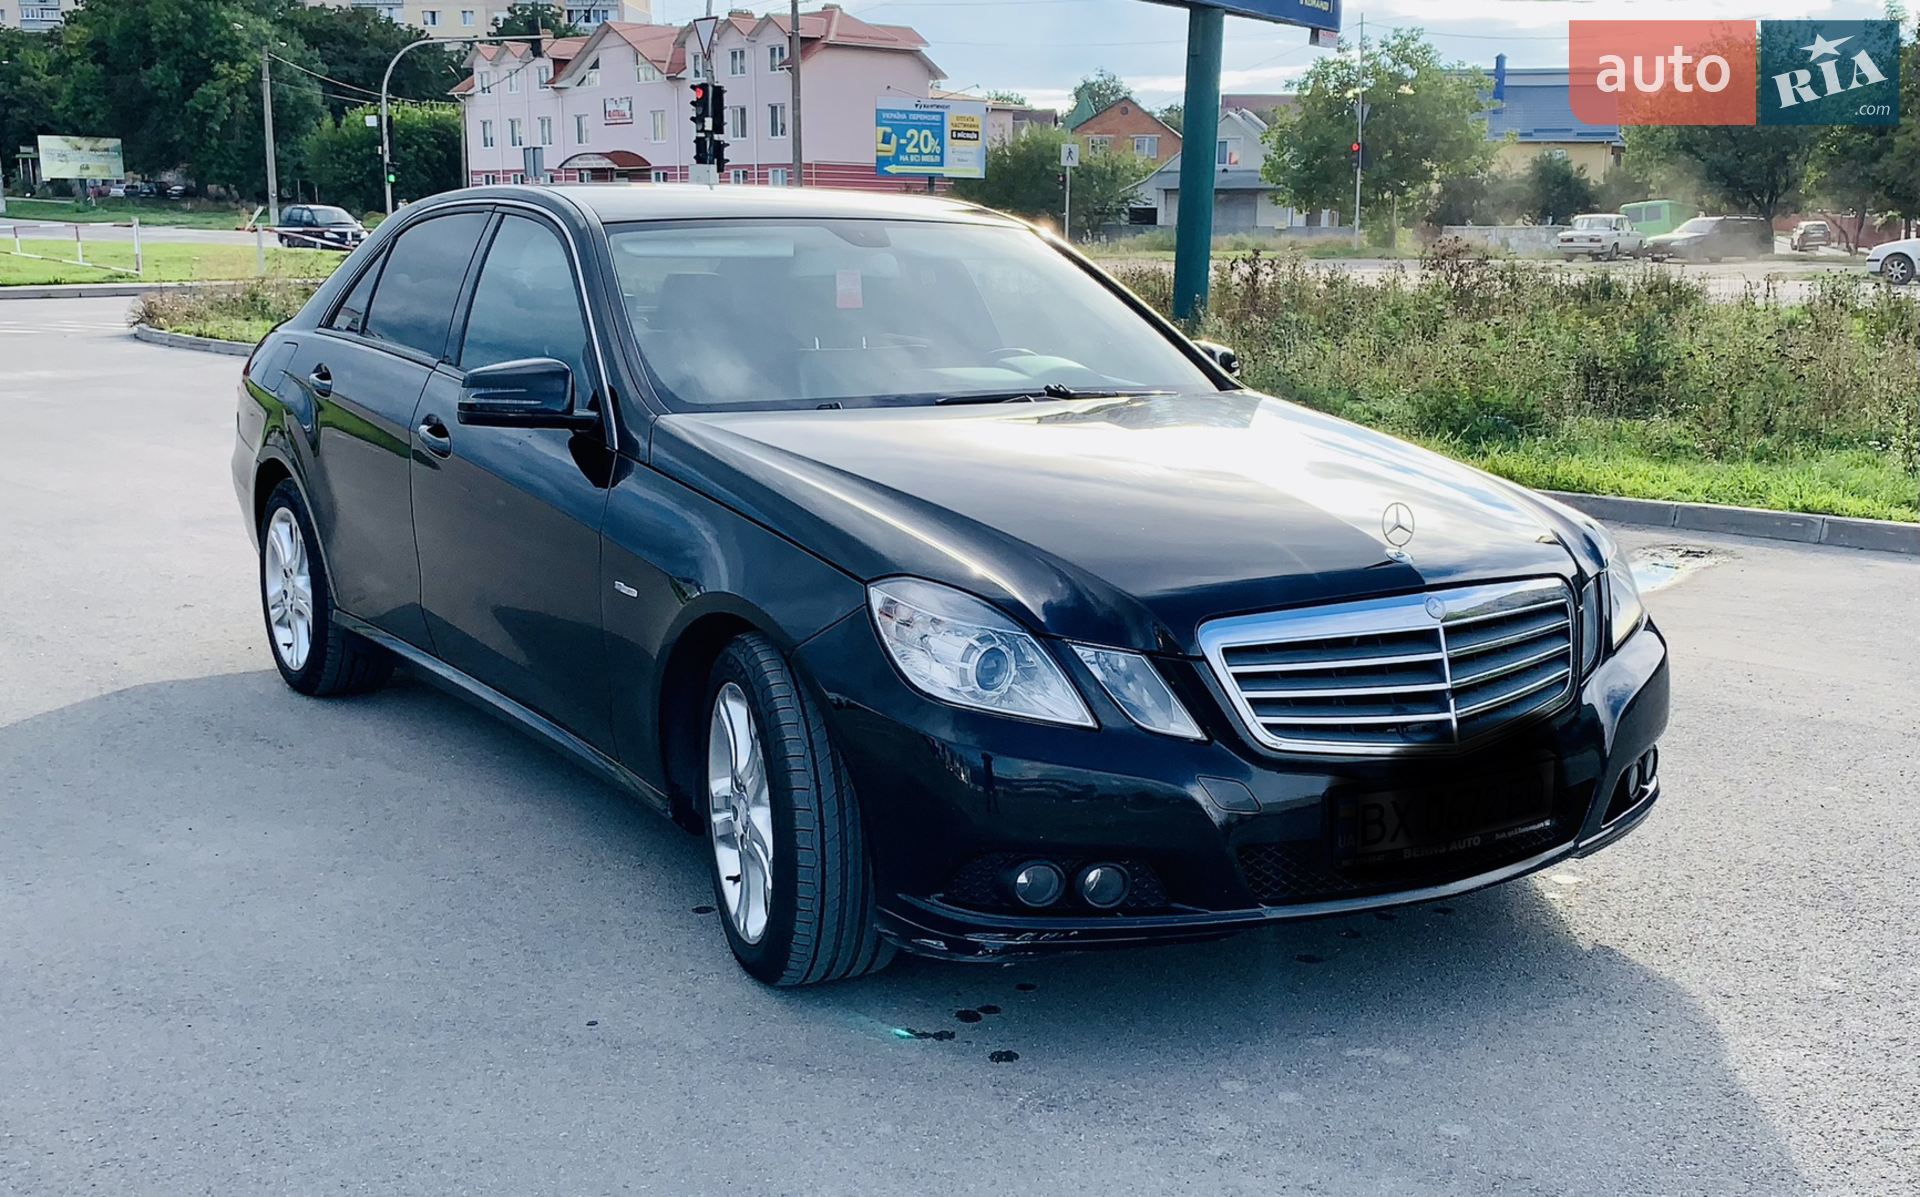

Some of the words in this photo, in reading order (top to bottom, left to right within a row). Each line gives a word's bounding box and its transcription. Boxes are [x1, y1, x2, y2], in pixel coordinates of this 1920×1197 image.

[882, 112, 907, 120] УКРАЇНА
[899, 129, 941, 154] -20%
[899, 154, 909, 162] НА
[910, 154, 920, 162] ВСІ
[1362, 799, 1413, 846] BX
[1337, 833, 1356, 850] UA
[1449, 835, 1482, 852] AUTO
